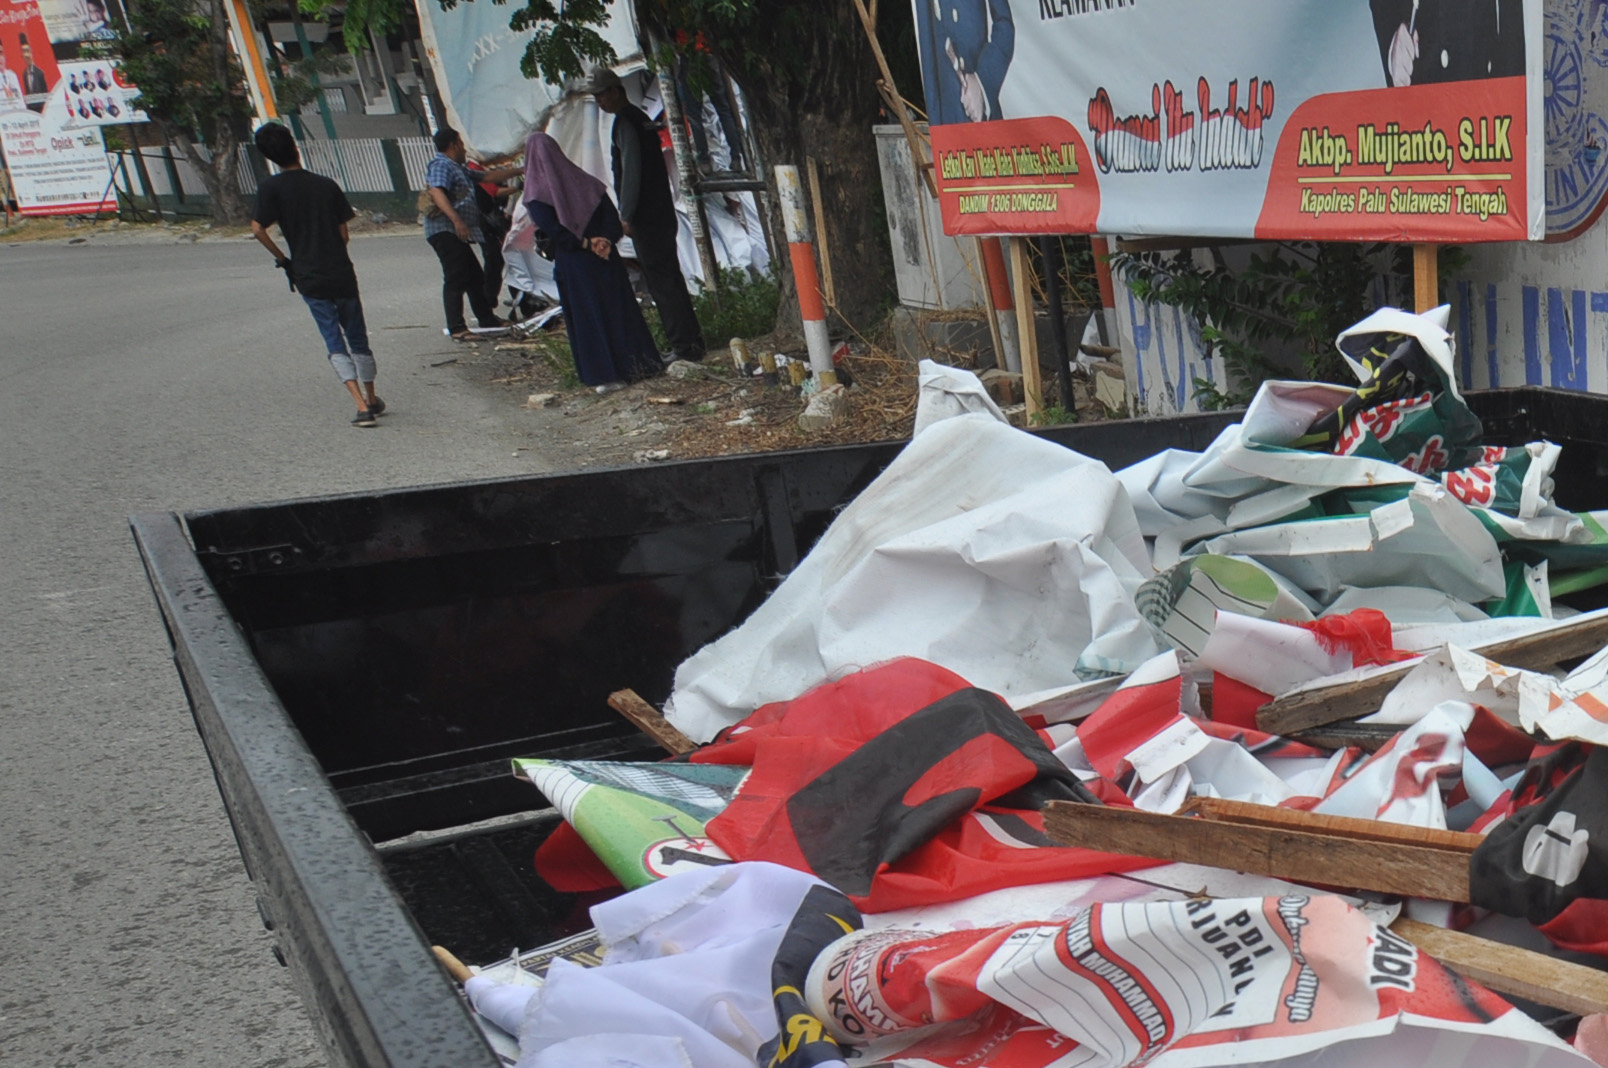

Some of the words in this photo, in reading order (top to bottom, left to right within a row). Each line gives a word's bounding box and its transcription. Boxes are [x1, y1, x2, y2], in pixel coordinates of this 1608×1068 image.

[1297, 126, 1352, 175] Akbp.
[1357, 120, 1454, 174] Mujianto,
[1458, 115, 1513, 163] S.I.K
[959, 195, 989, 215] DANDIM
[991, 194, 1011, 213] 1306
[1011, 192, 1058, 212] DONGGALA
[1300, 187, 1356, 218] Kapolres
[1358, 187, 1387, 214] Palu
[1390, 186, 1451, 213] Sulawesi
[1455, 186, 1507, 221] Tengah
[1222, 907, 1275, 962] PDI
